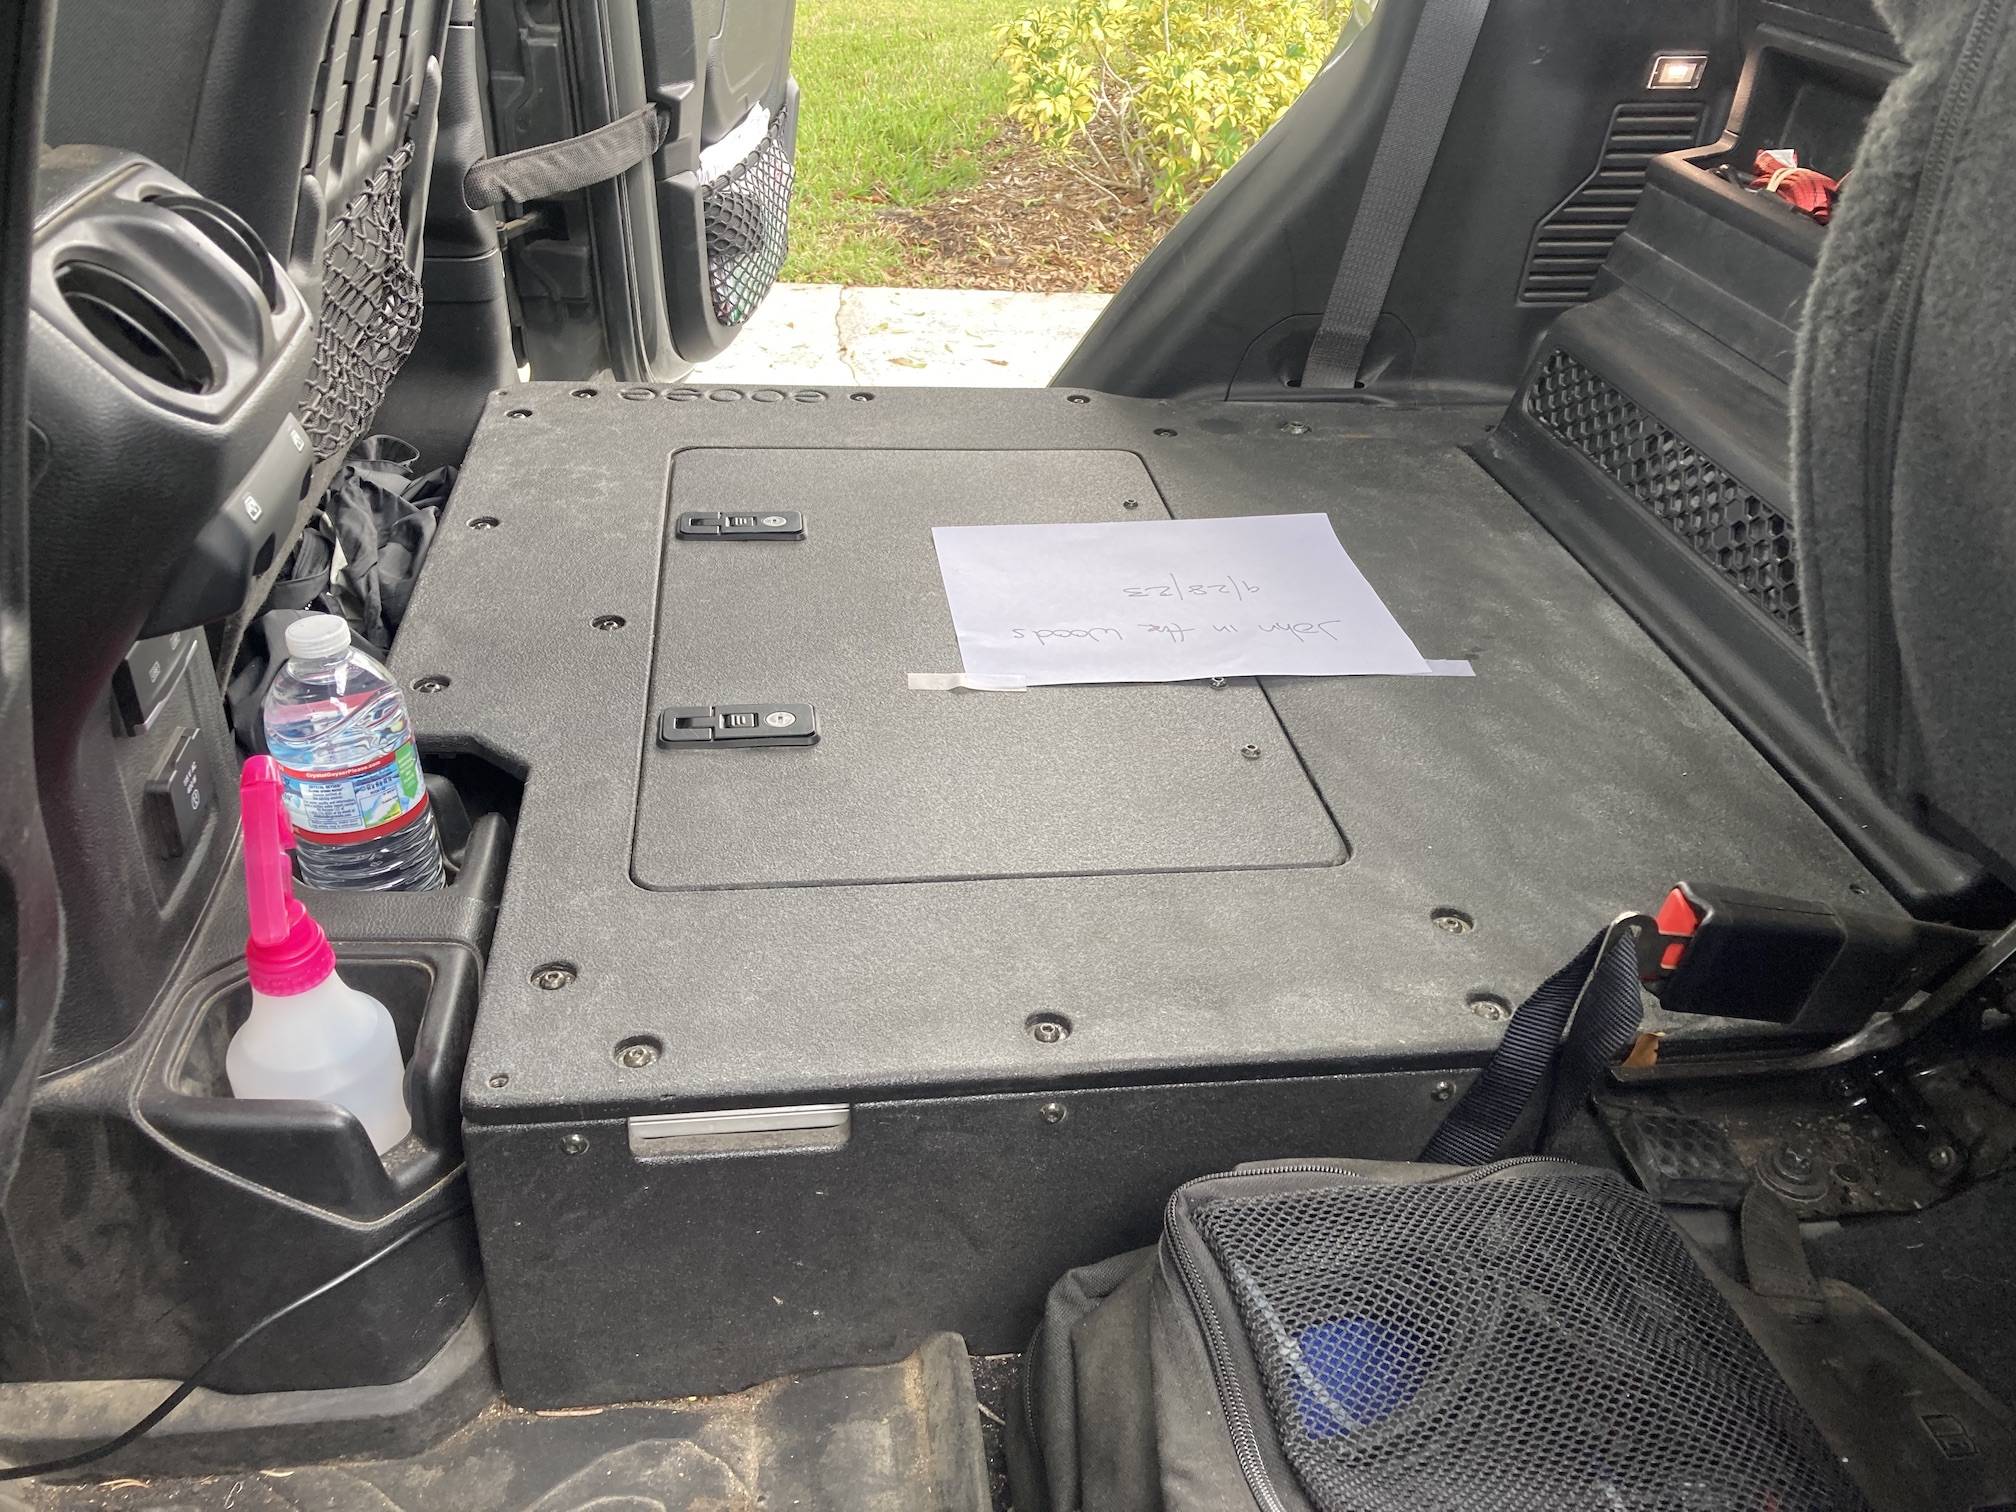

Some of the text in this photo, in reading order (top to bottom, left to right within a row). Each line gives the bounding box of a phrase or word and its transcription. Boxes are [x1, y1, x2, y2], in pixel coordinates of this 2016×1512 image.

[1123, 573, 1261, 600] 9/28/23
[1011, 619, 1342, 646] John in the Woods
